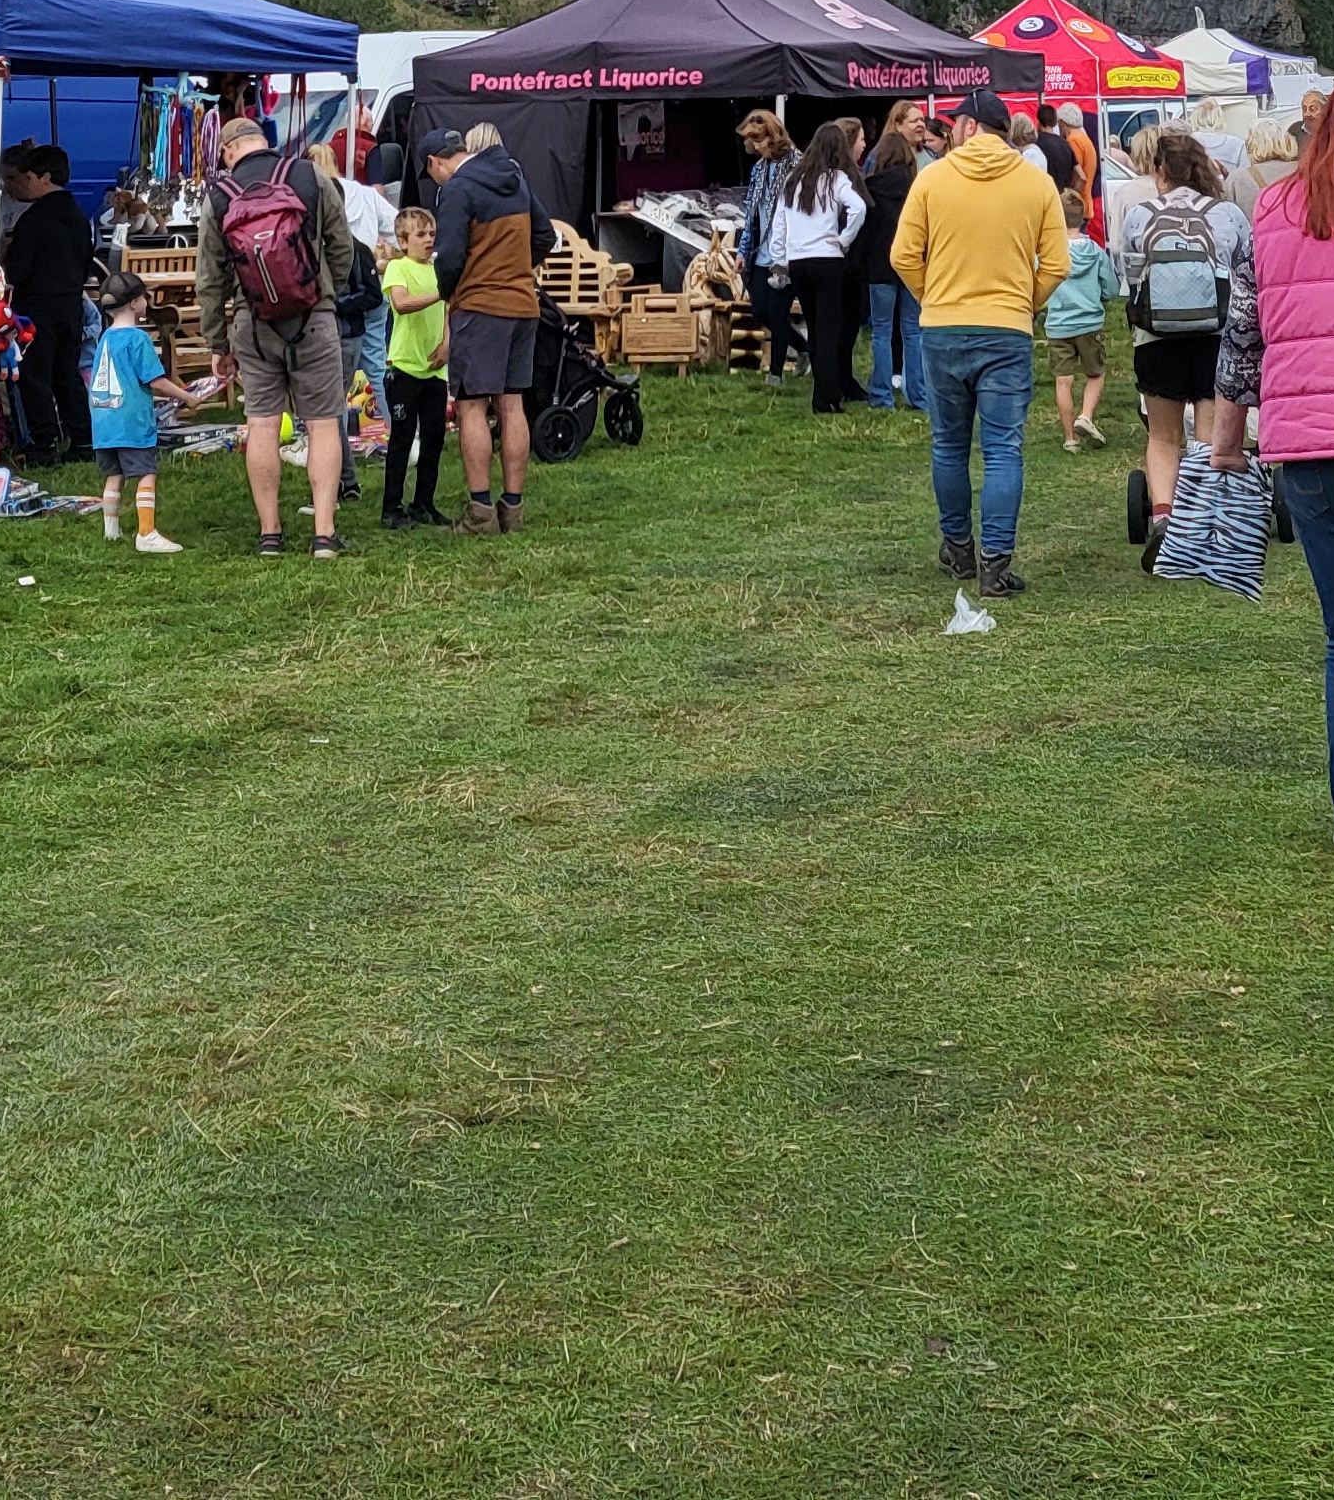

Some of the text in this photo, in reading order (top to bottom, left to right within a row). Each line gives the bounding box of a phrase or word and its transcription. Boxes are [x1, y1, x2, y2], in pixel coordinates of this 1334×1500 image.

[470, 67, 704, 92] Pontefract Liquorice
[846, 57, 991, 92] Pontefract Liquorice
